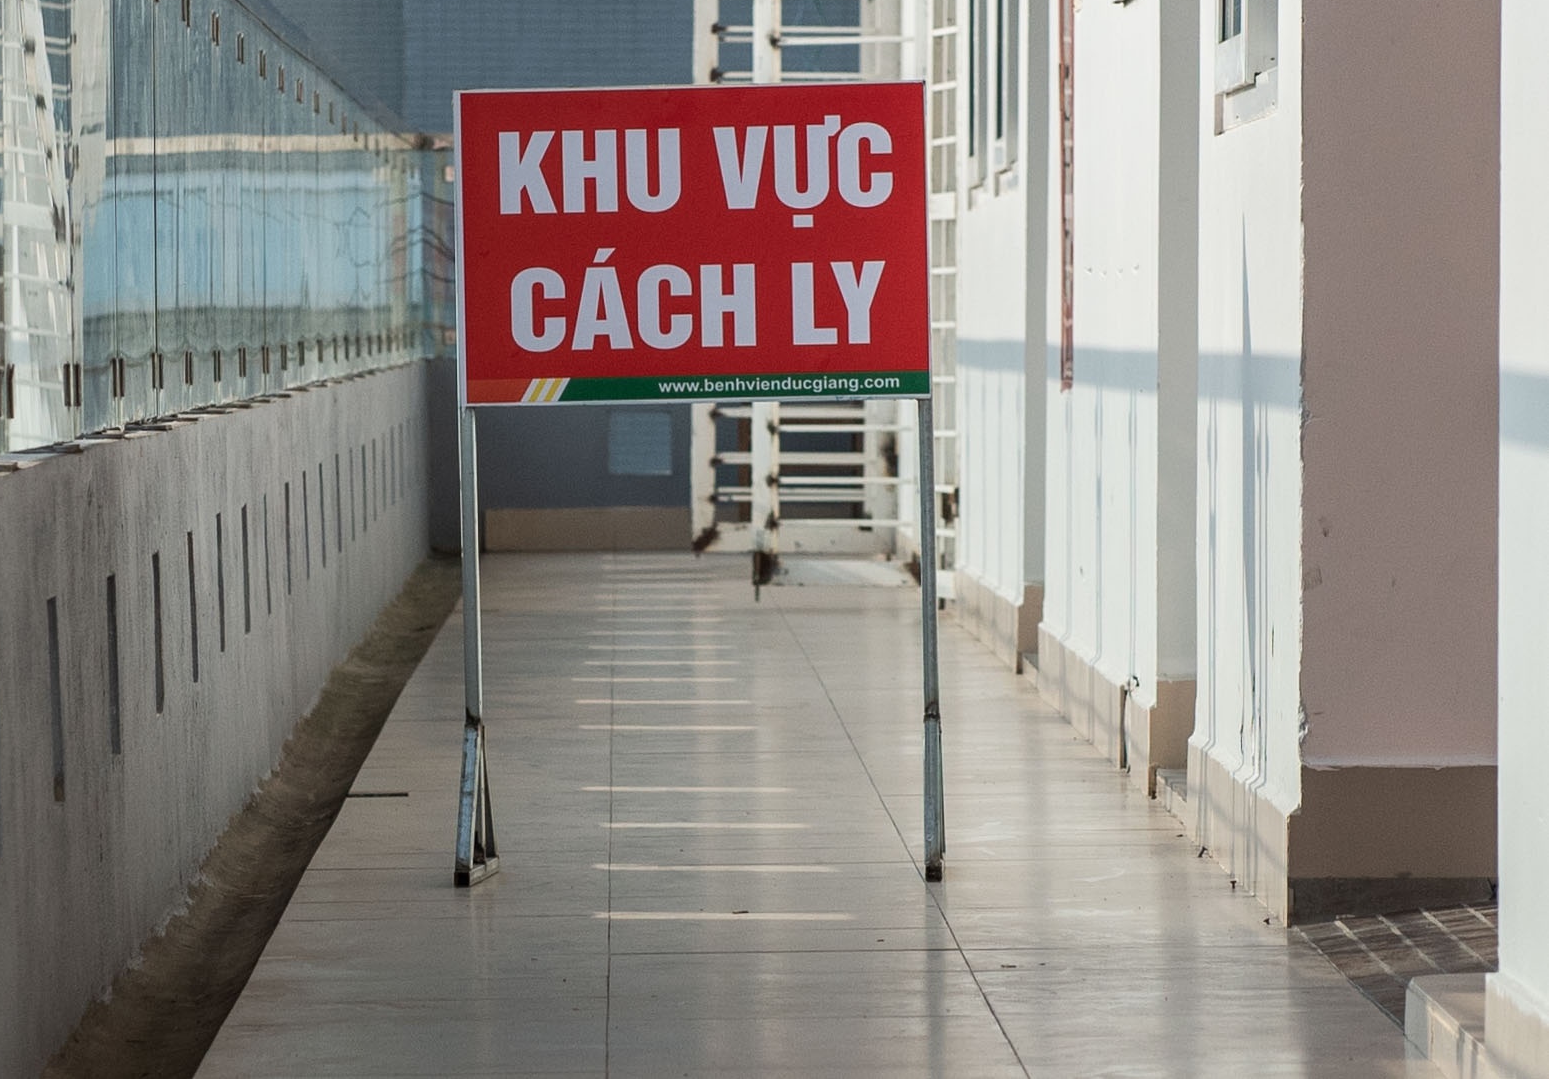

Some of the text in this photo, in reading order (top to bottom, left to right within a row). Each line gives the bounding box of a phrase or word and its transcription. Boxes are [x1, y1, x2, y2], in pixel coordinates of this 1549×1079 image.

[498, 114, 894, 228] KHU VỰC
[510, 247, 886, 353] CÁCH LY
[658, 376, 900, 395] www.benhvienducgiang.com
